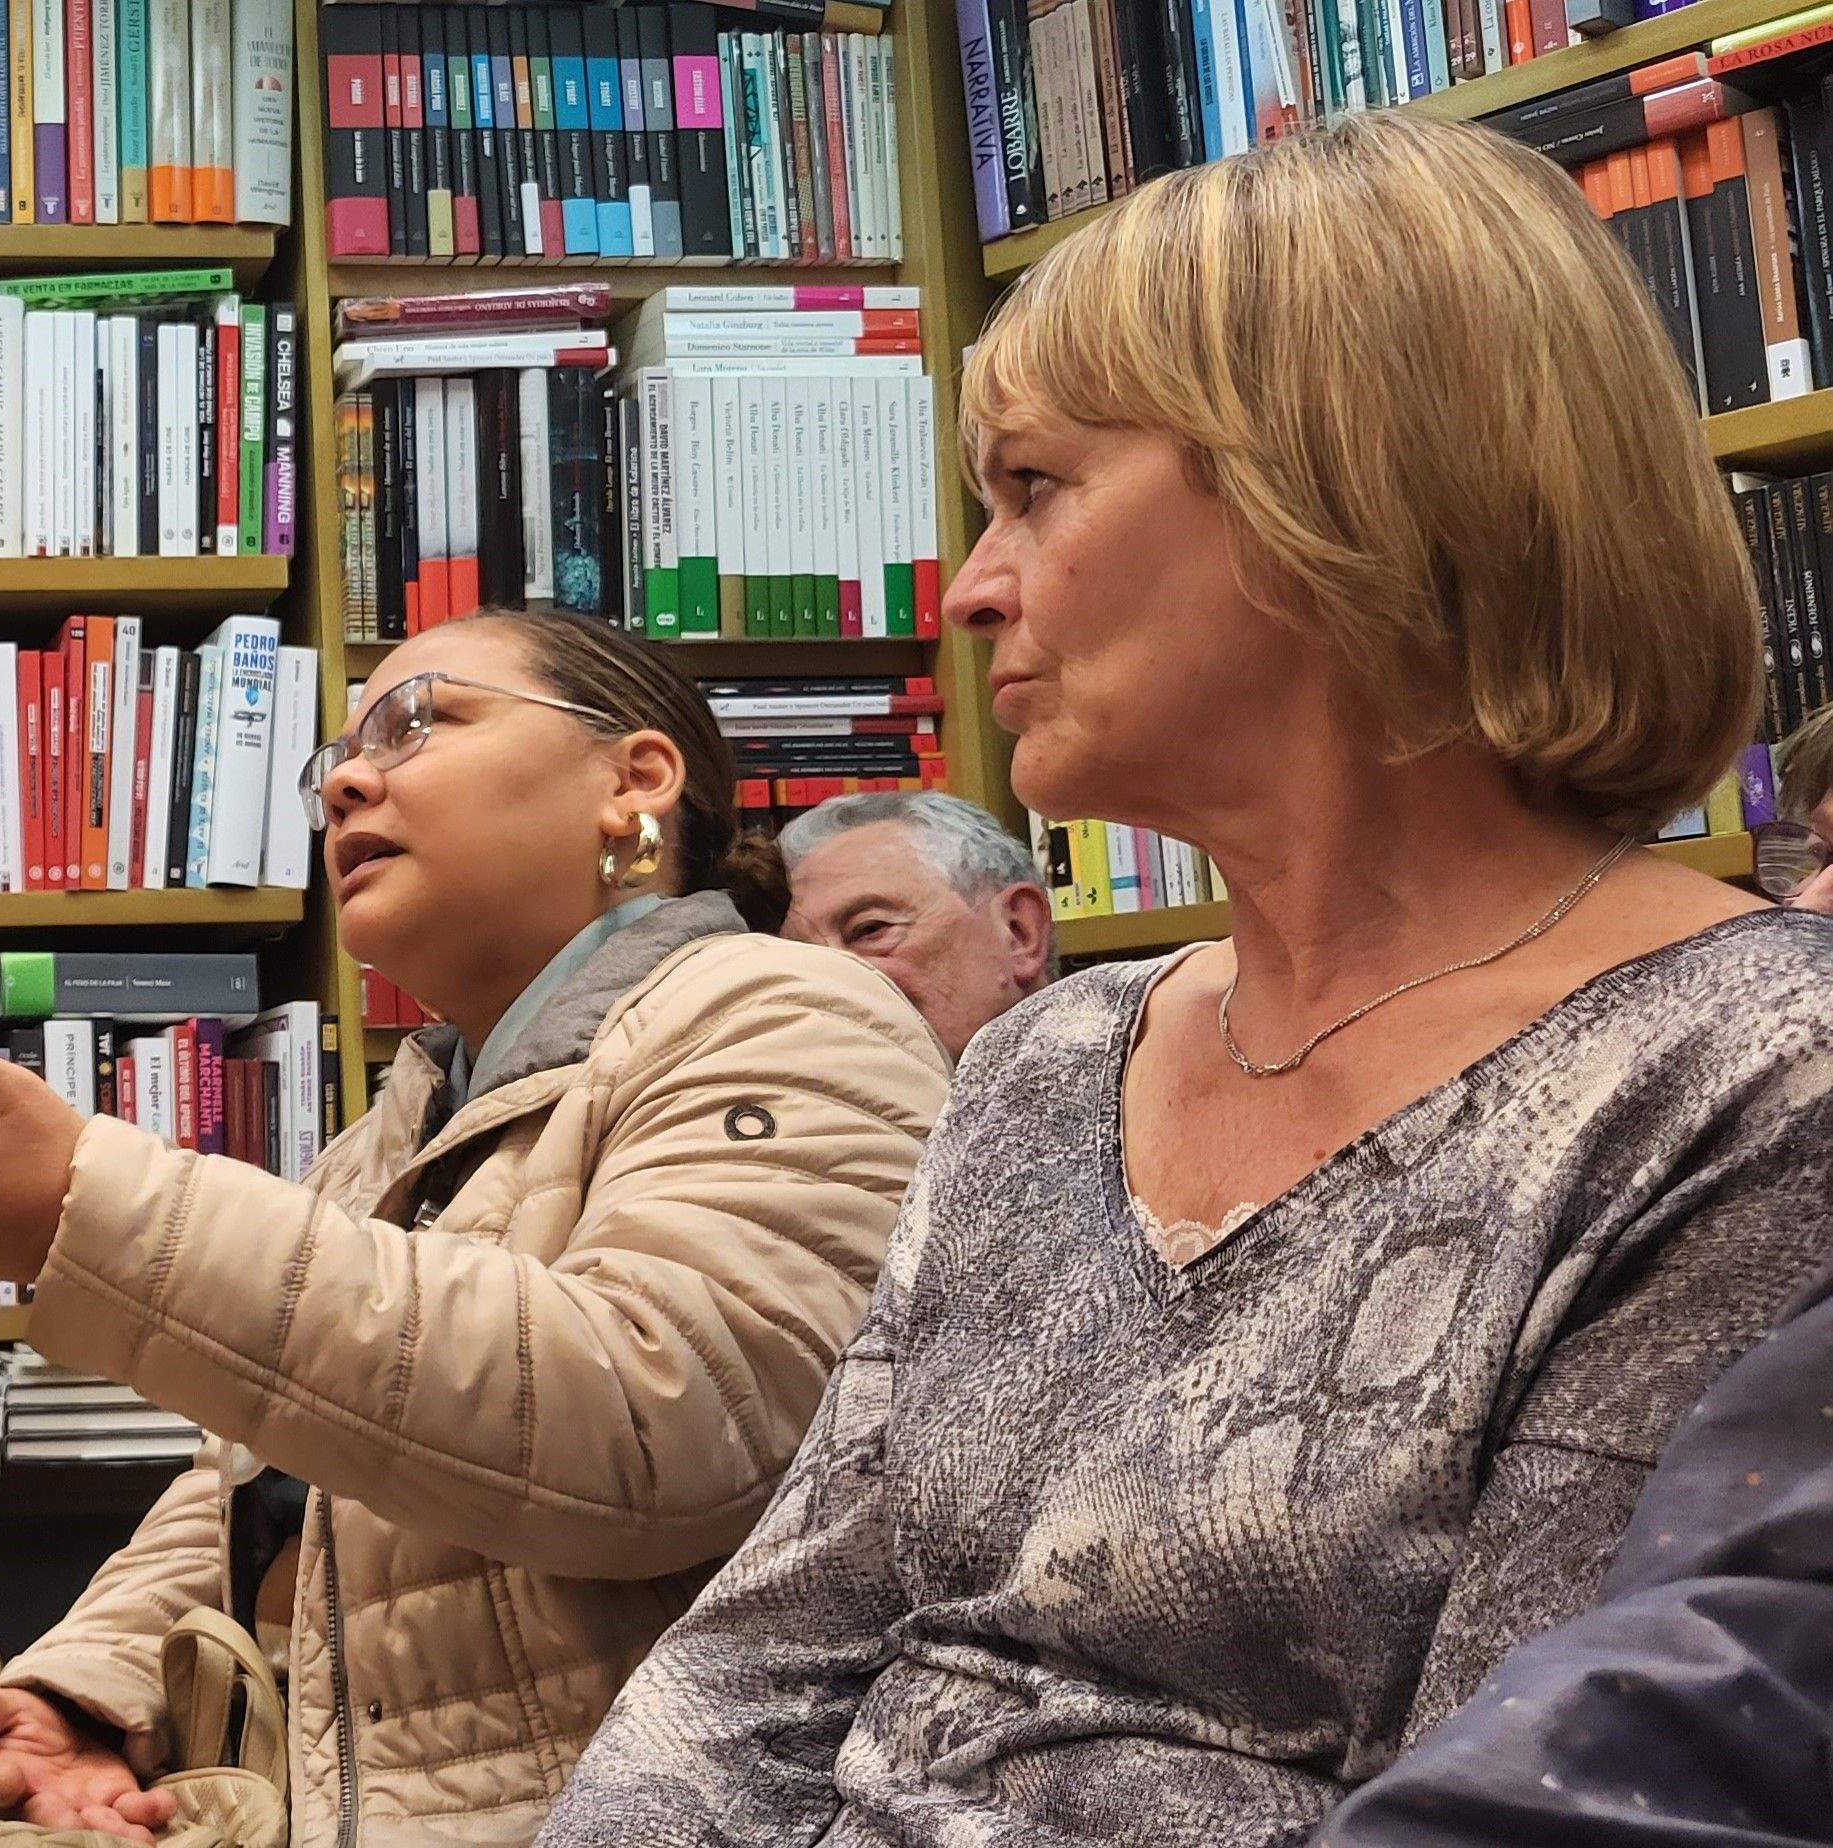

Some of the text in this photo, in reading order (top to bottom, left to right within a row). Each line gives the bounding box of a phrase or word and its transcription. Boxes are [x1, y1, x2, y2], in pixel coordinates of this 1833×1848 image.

[1754, 34, 1795, 61] ROSA
[965, 37, 996, 169] NARRATIVA
[1000, 87, 1026, 181] LOBARRE
[1813, 182, 1825, 212] PARQUE
[23, 283, 56, 295] VENTA
[688, 319, 765, 332] Natalia Ginzburg
[245, 323, 263, 380] INVASIÓN
[685, 341, 731, 354] Domenico
[244, 396, 261, 442] CAMPO
[276, 340, 291, 524] CHELSEA MANNING
[689, 401, 700, 431] Borges
[749, 402, 759, 455] Alba Donati
[771, 400, 781, 454] Alba Donati
[794, 403, 804, 456] Alba Donati
[817, 401, 827, 454] Alba Donati
[839, 401, 849, 425] Clara
[888, 401, 898, 421] Sara
[888, 423, 899, 464] Jaramillo
[650, 471, 660, 495] MUJER
[659, 424, 673, 534] DAVID MARTÍNEZ ÁLVAREZ
[652, 497, 660, 523] CACTUS
[232, 652, 276, 671] BAÑOS
[234, 633, 278, 649] PEDRO
[231, 677, 273, 691] MUNDIAL
[65, 1034, 78, 1098] PRÍNCIPE
[149, 1056, 162, 1110] El mejor
[199, 1043, 212, 1135] MARCHANTE
[212, 1056, 223, 1123] KARMELE
